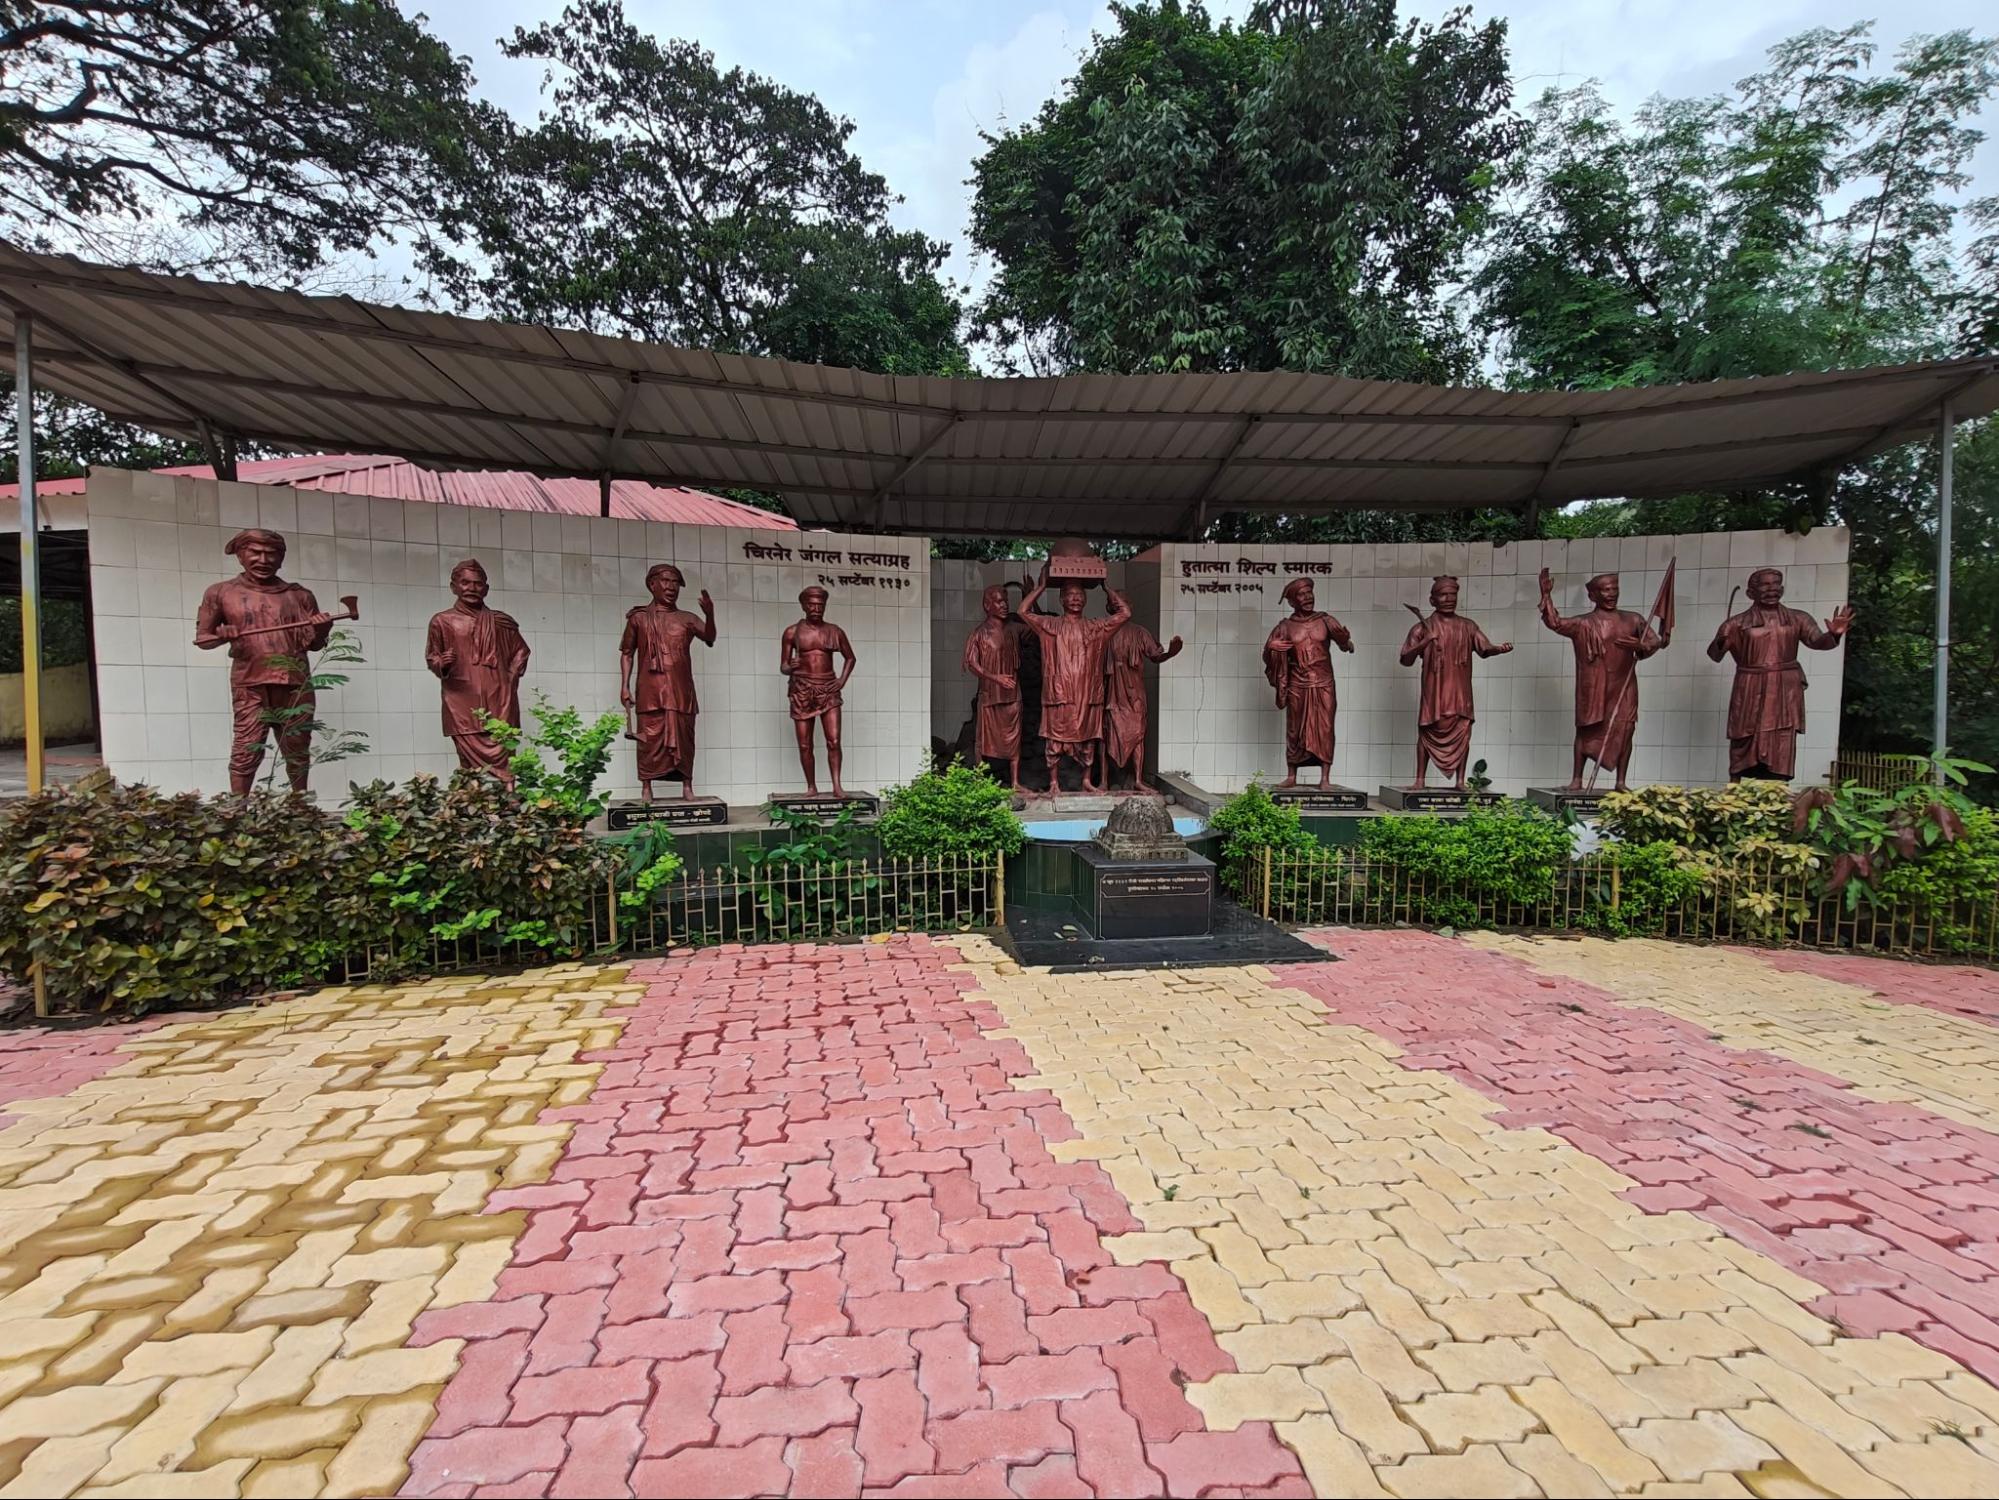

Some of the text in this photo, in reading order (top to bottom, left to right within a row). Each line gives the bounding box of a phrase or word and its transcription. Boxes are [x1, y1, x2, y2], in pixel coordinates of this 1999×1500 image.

[743, 542, 911, 570] चिरनेर जंगल सत्याग्रह
[1181, 558, 1333, 577] हुतात्मा शिल्प स्मारक
[818, 574, 835, 587] २५
[1181, 584, 1195, 595] २५
[1235, 583, 1264, 594] २००५
